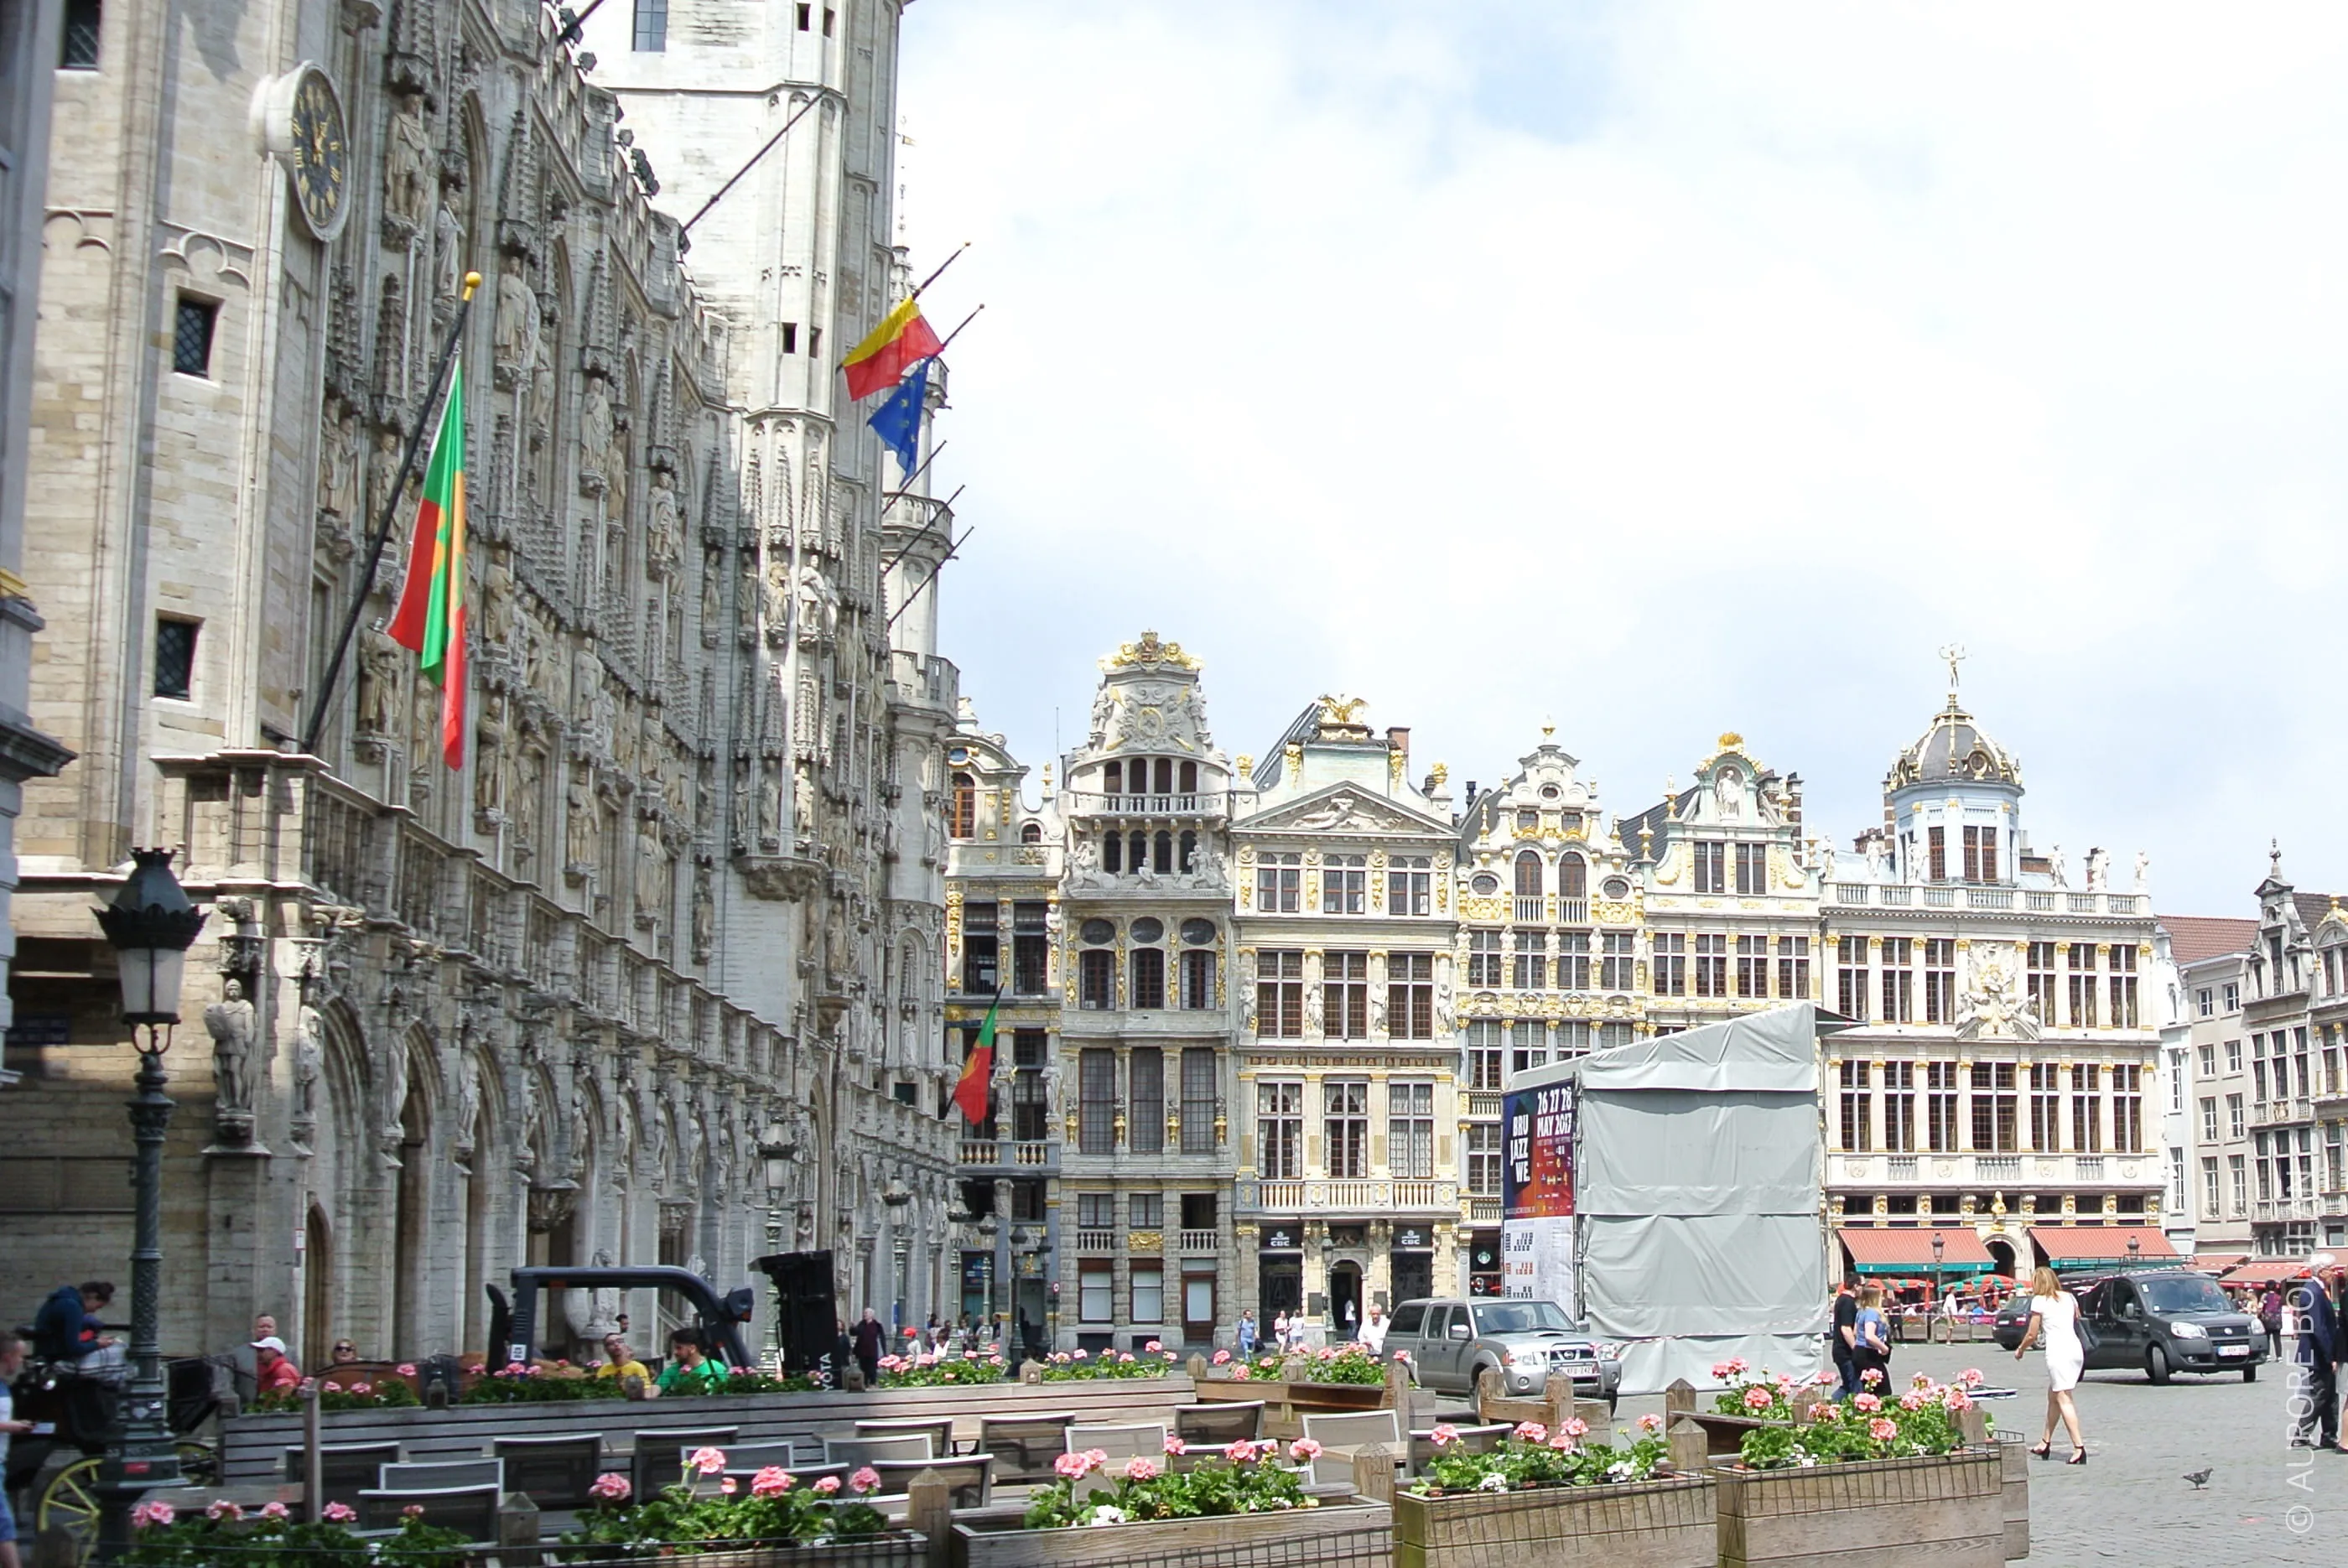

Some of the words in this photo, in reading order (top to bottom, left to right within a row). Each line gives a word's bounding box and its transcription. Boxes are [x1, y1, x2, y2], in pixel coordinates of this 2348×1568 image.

[1537, 1091, 1549, 1115] 26
[1550, 1088, 1560, 1113] 27
[1561, 1086, 1572, 1111] 28
[1513, 1114, 1529, 1137] BRU
[1536, 1115, 1555, 1138] MAY
[1555, 1113, 1572, 1135] 2017
[1510, 1137, 1529, 1166] JAZZ
[819, 1353, 834, 1392] YOTA
